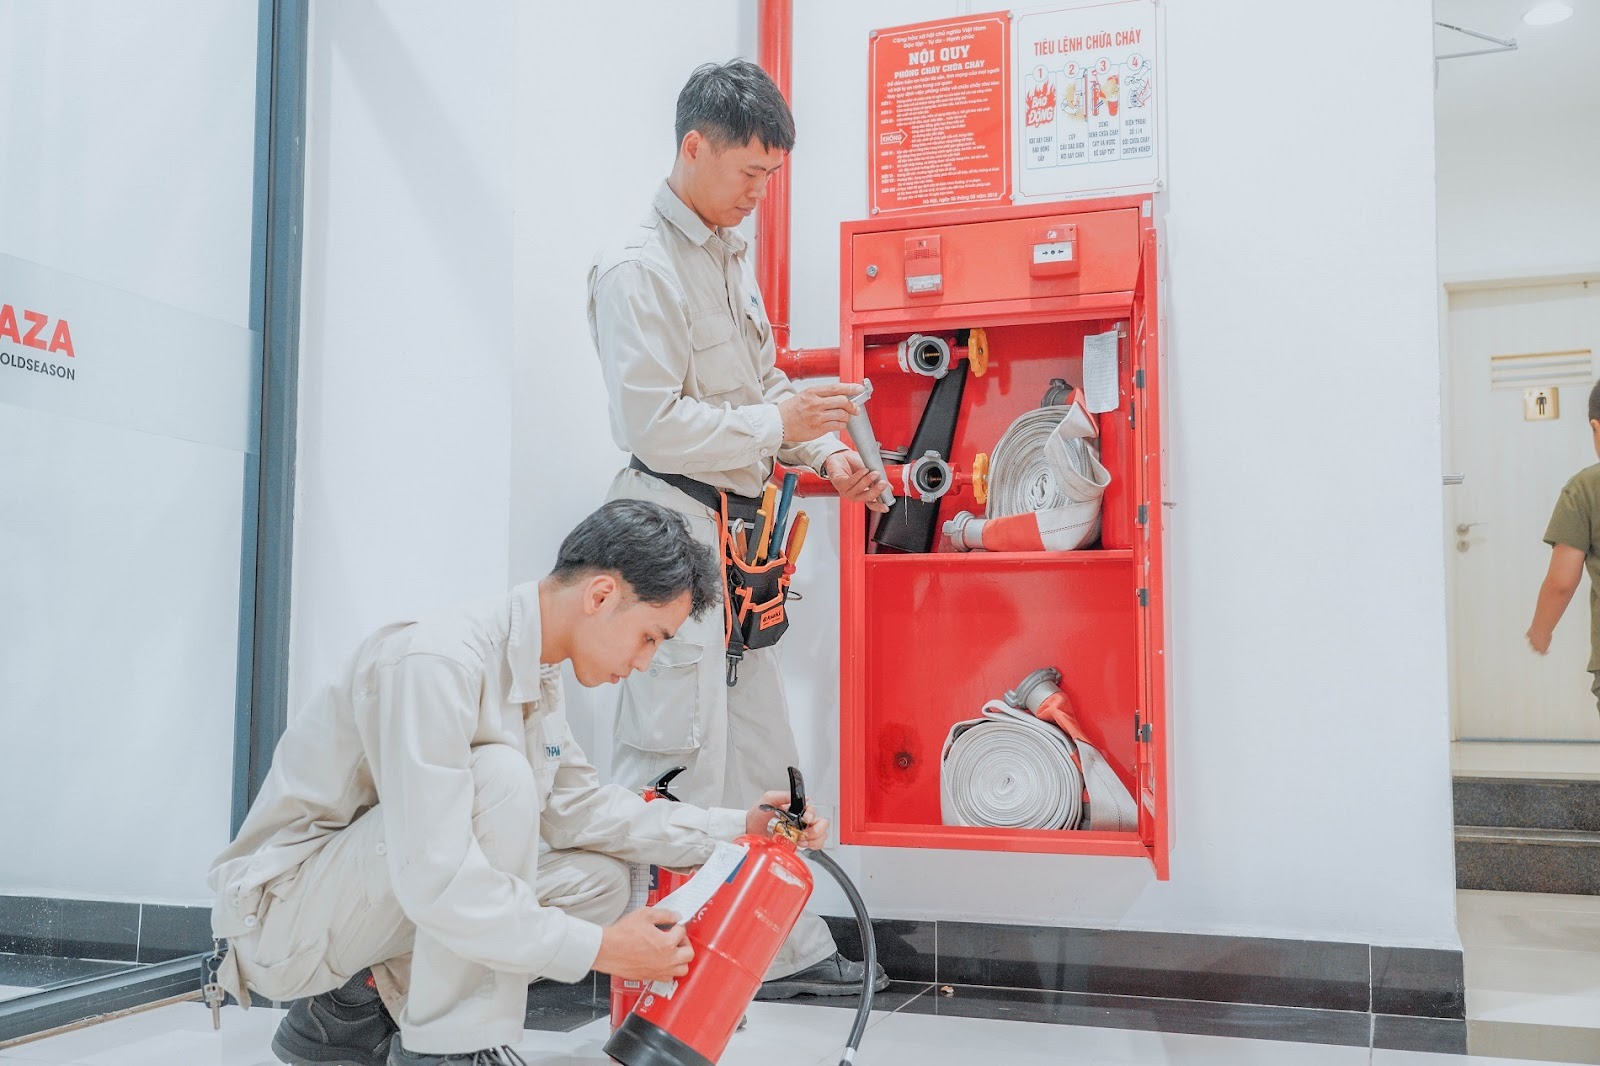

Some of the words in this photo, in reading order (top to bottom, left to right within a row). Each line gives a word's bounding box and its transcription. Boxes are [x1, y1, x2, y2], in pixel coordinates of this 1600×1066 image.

[1058, 36, 1082, 55] LỆNH
[1086, 30, 1112, 50] CHỮA
[1116, 27, 1141, 46] CHÁY
[908, 48, 935, 66] NỘI
[940, 45, 970, 60] QUY
[1132, 56, 1138, 67] 4
[894, 67, 919, 79] PHÒNG
[920, 65, 940, 77] CHÁY
[942, 62, 963, 73] CHỮA
[965, 59, 985, 70] CHÁY
[1038, 68, 1043, 78] 1
[1069, 64, 1075, 75] 2
[1100, 60, 1106, 72] 3
[1031, 94, 1048, 108] BÁO
[0, 304, 76, 358] AZA
[0, 352, 75, 380] OLDSEASON
